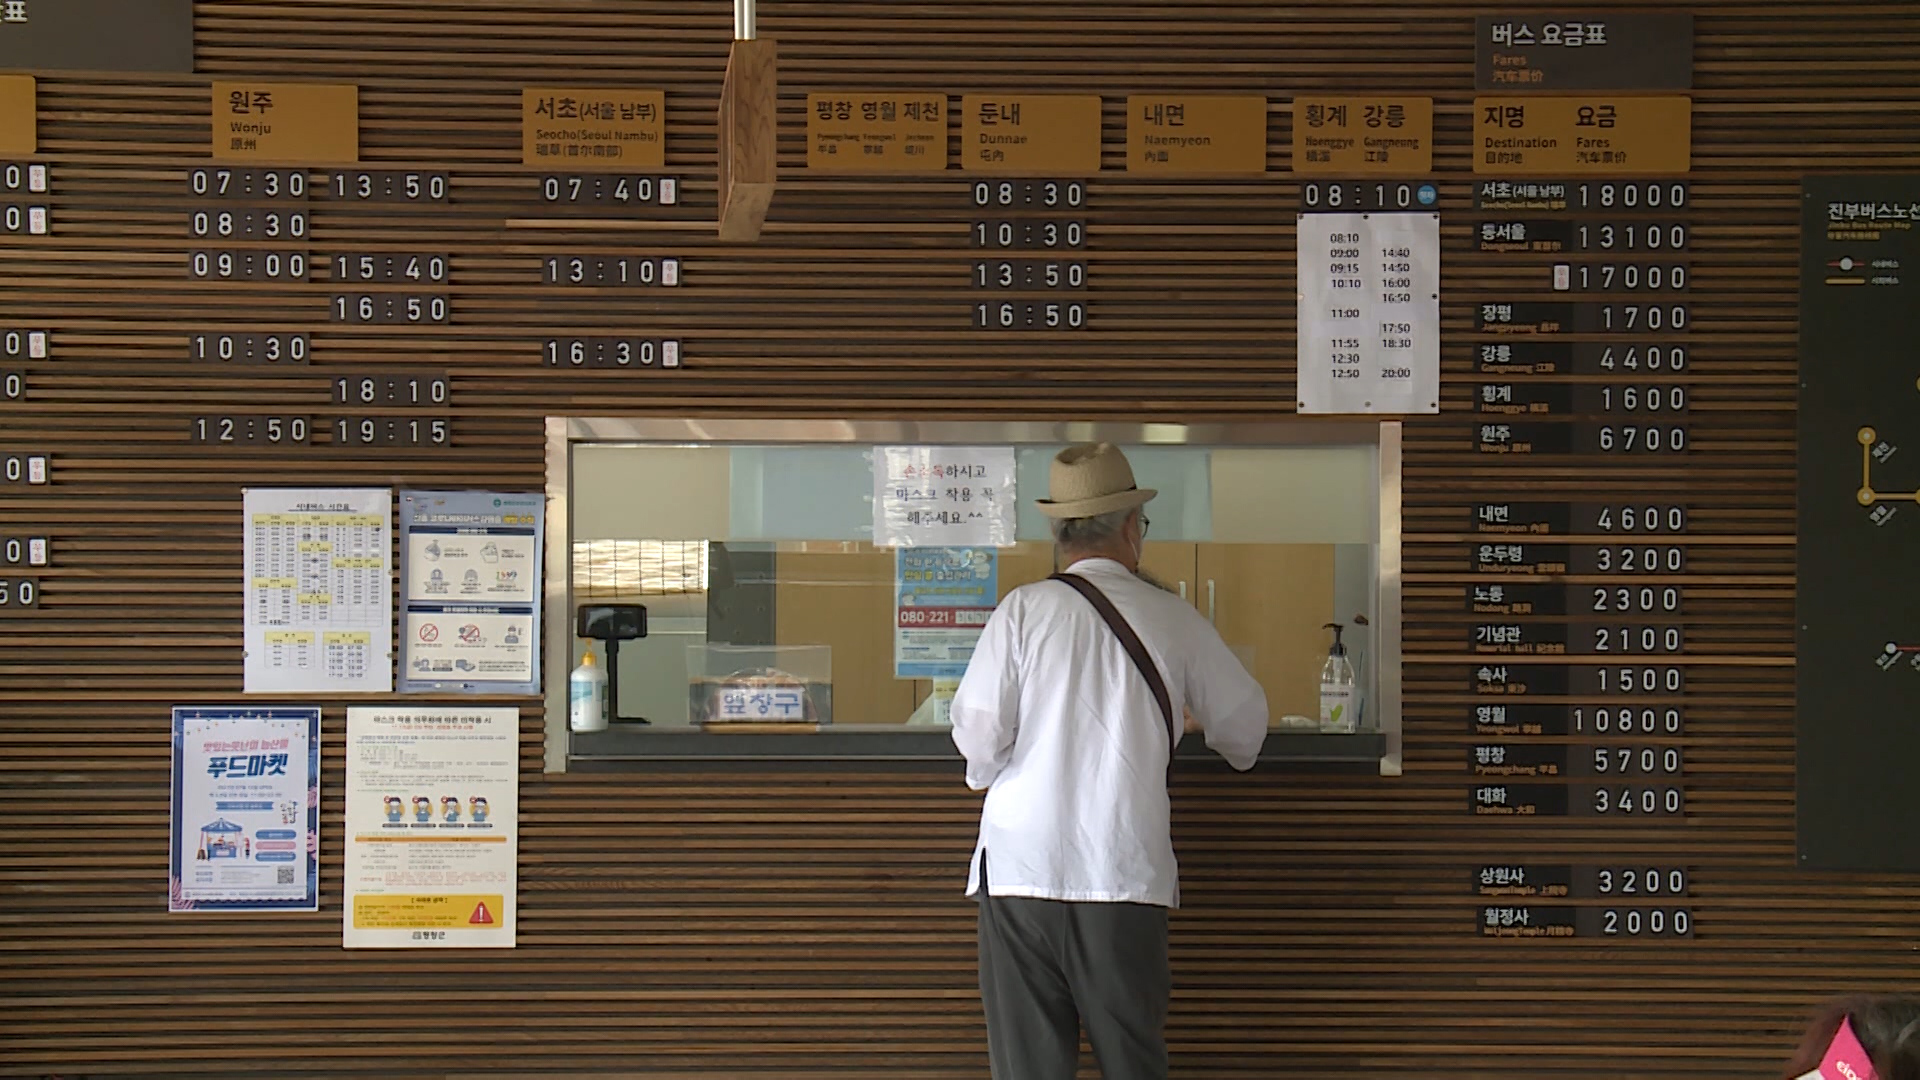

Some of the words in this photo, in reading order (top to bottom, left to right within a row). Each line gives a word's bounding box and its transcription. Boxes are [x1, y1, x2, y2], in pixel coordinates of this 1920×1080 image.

[0, 1, 29, 23] 표
[1491, 23, 1535, 47] 버스
[1541, 23, 1607, 47] 요금표
[1493, 55, 1527, 66] Fares
[229, 91, 274, 115] 원주
[535, 97, 615, 121] 서초(서울
[620, 103, 656, 122] 남부)
[816, 101, 853, 121] 평창
[861, 101, 897, 122] 영월
[904, 101, 939, 122] 제천
[978, 103, 1021, 126] 둔내
[1143, 104, 1185, 127] 내면
[1305, 104, 1347, 128] 횡계
[1363, 104, 1405, 128] 강릉
[1484, 106, 1524, 128] 지명
[1575, 106, 1617, 128] 요금
[230, 121, 271, 136] Wonju
[536, 129, 612, 142] Seocho(Seoul
[615, 131, 658, 143] Nambu)
[979, 133, 1028, 144] Dunnae
[1145, 135, 1211, 148] Naemyeon
[1485, 137, 1557, 148] Destination
[1576, 137, 1610, 148] Fares
[192, 171, 304, 197] 07:30
[335, 174, 444, 199] 13:50
[545, 179, 651, 201] 07:40
[976, 183, 1081, 206] 08:30
[1305, 184, 1411, 207] 08:10
[1579, 185, 1684, 207] 18000
[193, 213, 304, 237] 08:30
[977, 222, 1081, 246] 10:30
[1481, 223, 1526, 241] 동서울
[1330, 233, 1359, 243] 08:10
[1579, 225, 1684, 248] 13100
[1330, 249, 1359, 258] 09:00
[1381, 248, 1410, 258] 14:40
[193, 253, 304, 278] 09:00
[337, 255, 444, 281] 15:40
[548, 259, 654, 282] 13:10
[977, 264, 1082, 287] 13:50
[1330, 264, 1359, 273] 09:15
[1381, 263, 1410, 272] 14:50
[1579, 265, 1685, 288] 17000
[1331, 279, 1361, 288] 10:10
[1382, 278, 1410, 288] 16:00
[337, 297, 445, 320] 16:50
[1382, 293, 1410, 303] 16:50
[978, 304, 1082, 327] 16:50
[1331, 309, 1360, 318] 11:00
[1482, 304, 1512, 322] 장평
[1603, 307, 1685, 329] 1700
[1382, 323, 1410, 333] 17:50
[197, 337, 304, 361] 10:30
[548, 341, 654, 364] 16:30
[1331, 339, 1360, 348] 11:55
[1382, 339, 1411, 348] 18:30
[1481, 345, 1512, 362] 강릉
[1331, 354, 1360, 364] 12:30
[1600, 347, 1684, 370] 4400
[1331, 369, 1360, 378] 12:50
[1381, 368, 1410, 378] 20:00
[338, 379, 445, 403] 18:10
[1481, 385, 1512, 402] 횡계
[1602, 387, 1684, 410] 1600
[198, 418, 305, 442] 12:50
[338, 418, 446, 443] 19:15
[1481, 425, 1511, 442] 원주
[1600, 427, 1684, 450] 6700
[896, 488, 938, 501] 마스크
[946, 488, 973, 502] 착용
[980, 488, 994, 502] 꼭
[1478, 505, 1508, 522] 내면
[1598, 507, 1682, 530] 4600
[1478, 545, 1523, 563] 운두령
[1597, 548, 1681, 571] 3200
[1593, 588, 1677, 610] 2300
[1476, 625, 1521, 643] 기념관
[1595, 628, 1678, 650] 2100
[1477, 666, 1507, 682] 속사
[1598, 669, 1680, 691] 1500
[1476, 706, 1506, 724] 영월
[1574, 709, 1679, 732] 10800
[207, 753, 289, 779] 푸드마켓
[1475, 746, 1506, 764] 평창
[1594, 749, 1678, 772] 5700
[1476, 787, 1507, 804] 대화
[1595, 789, 1679, 813] 3400
[1480, 868, 1524, 884] 상원사
[1599, 870, 1683, 892] 3200
[1485, 908, 1529, 925] 월정사
[1603, 911, 1688, 934] 2000
